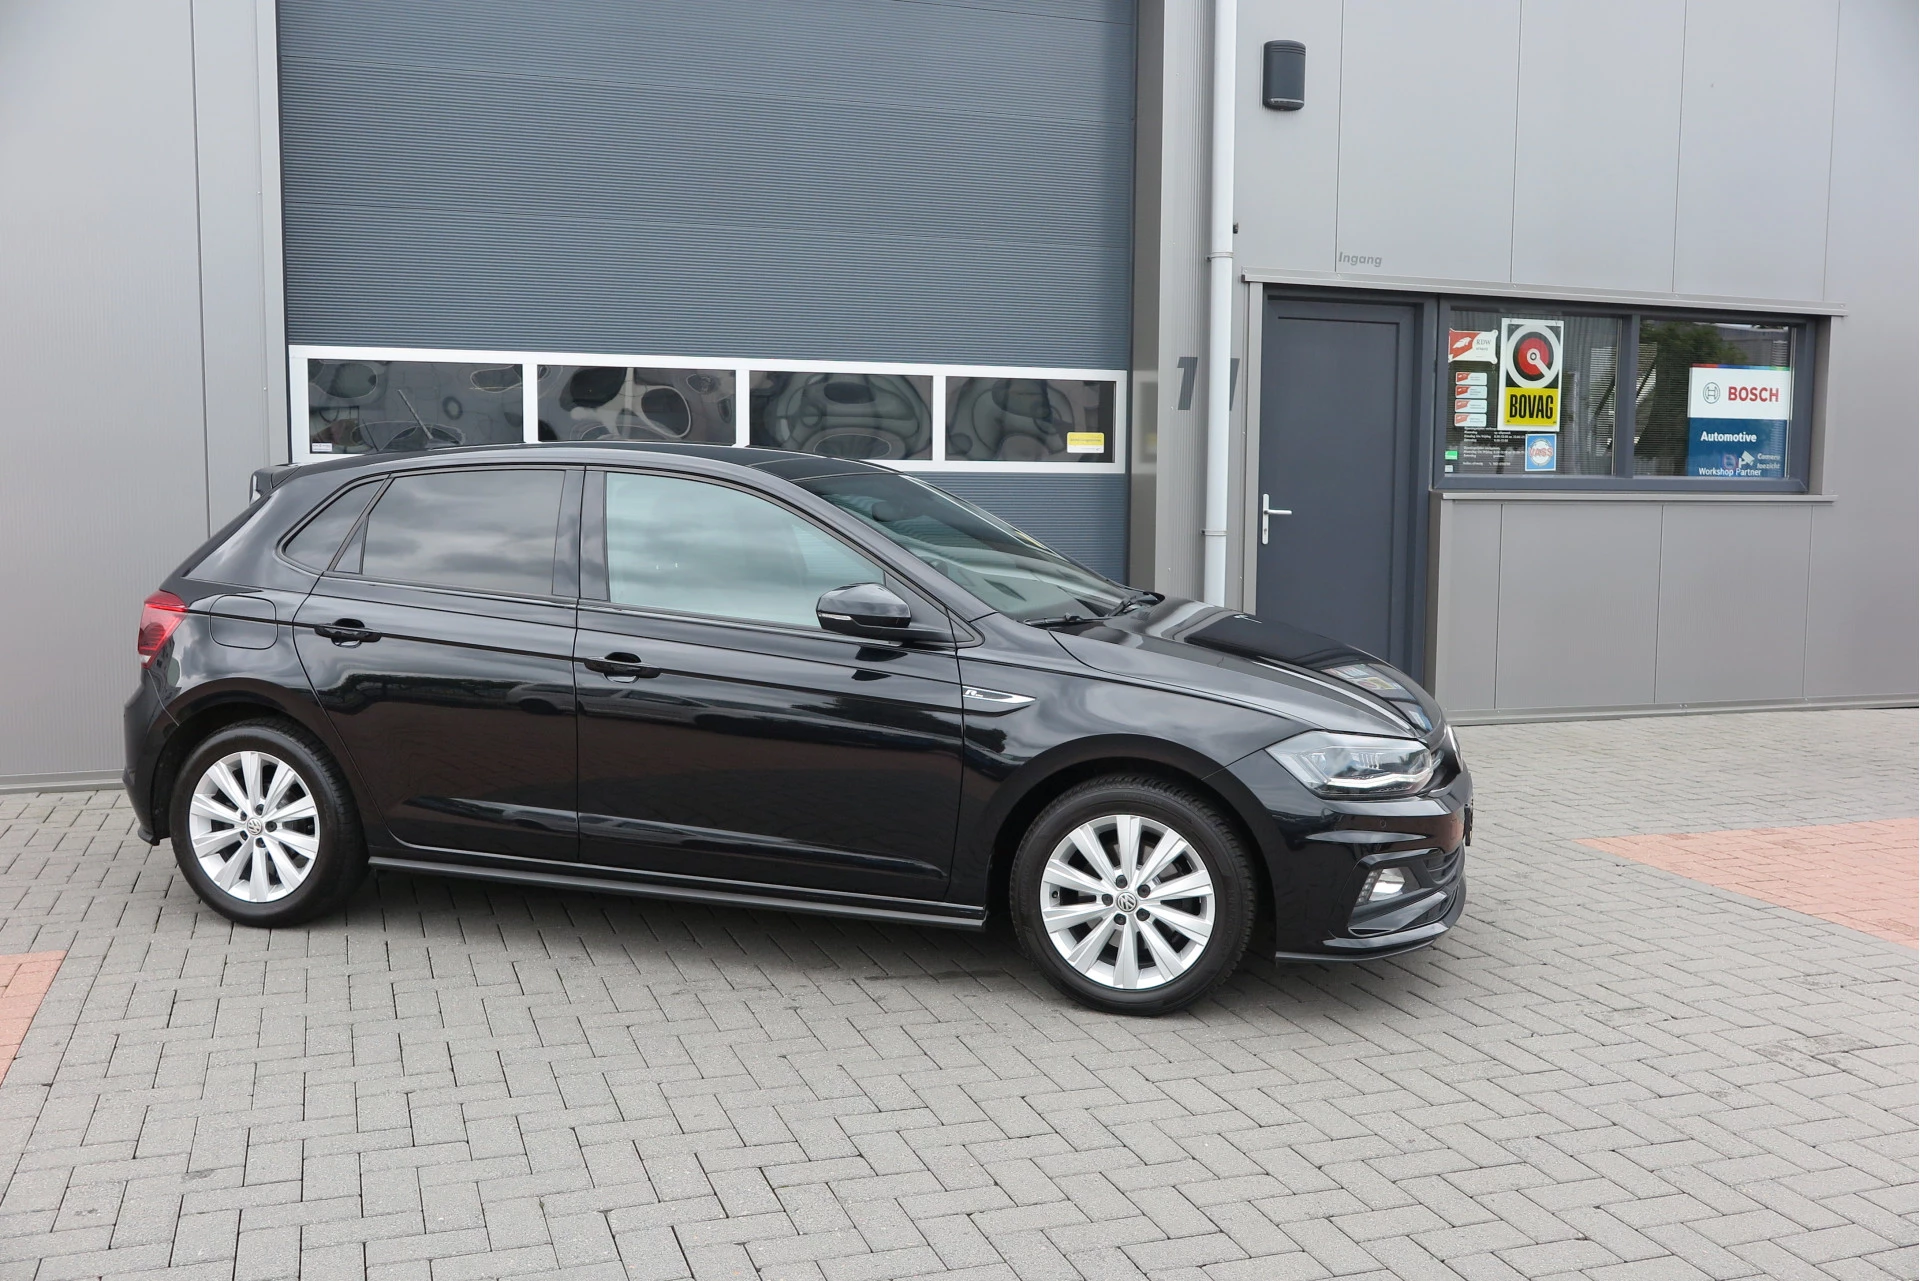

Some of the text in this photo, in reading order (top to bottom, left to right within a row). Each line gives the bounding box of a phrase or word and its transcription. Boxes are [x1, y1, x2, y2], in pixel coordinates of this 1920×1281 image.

[1338, 251, 1382, 268] Ingang
[1727, 386, 1780, 403] BOSCH
[1509, 394, 1554, 419] BOVAG
[1700, 431, 1757, 443] Automotive
[1698, 467, 1762, 477] Workshop Partner
